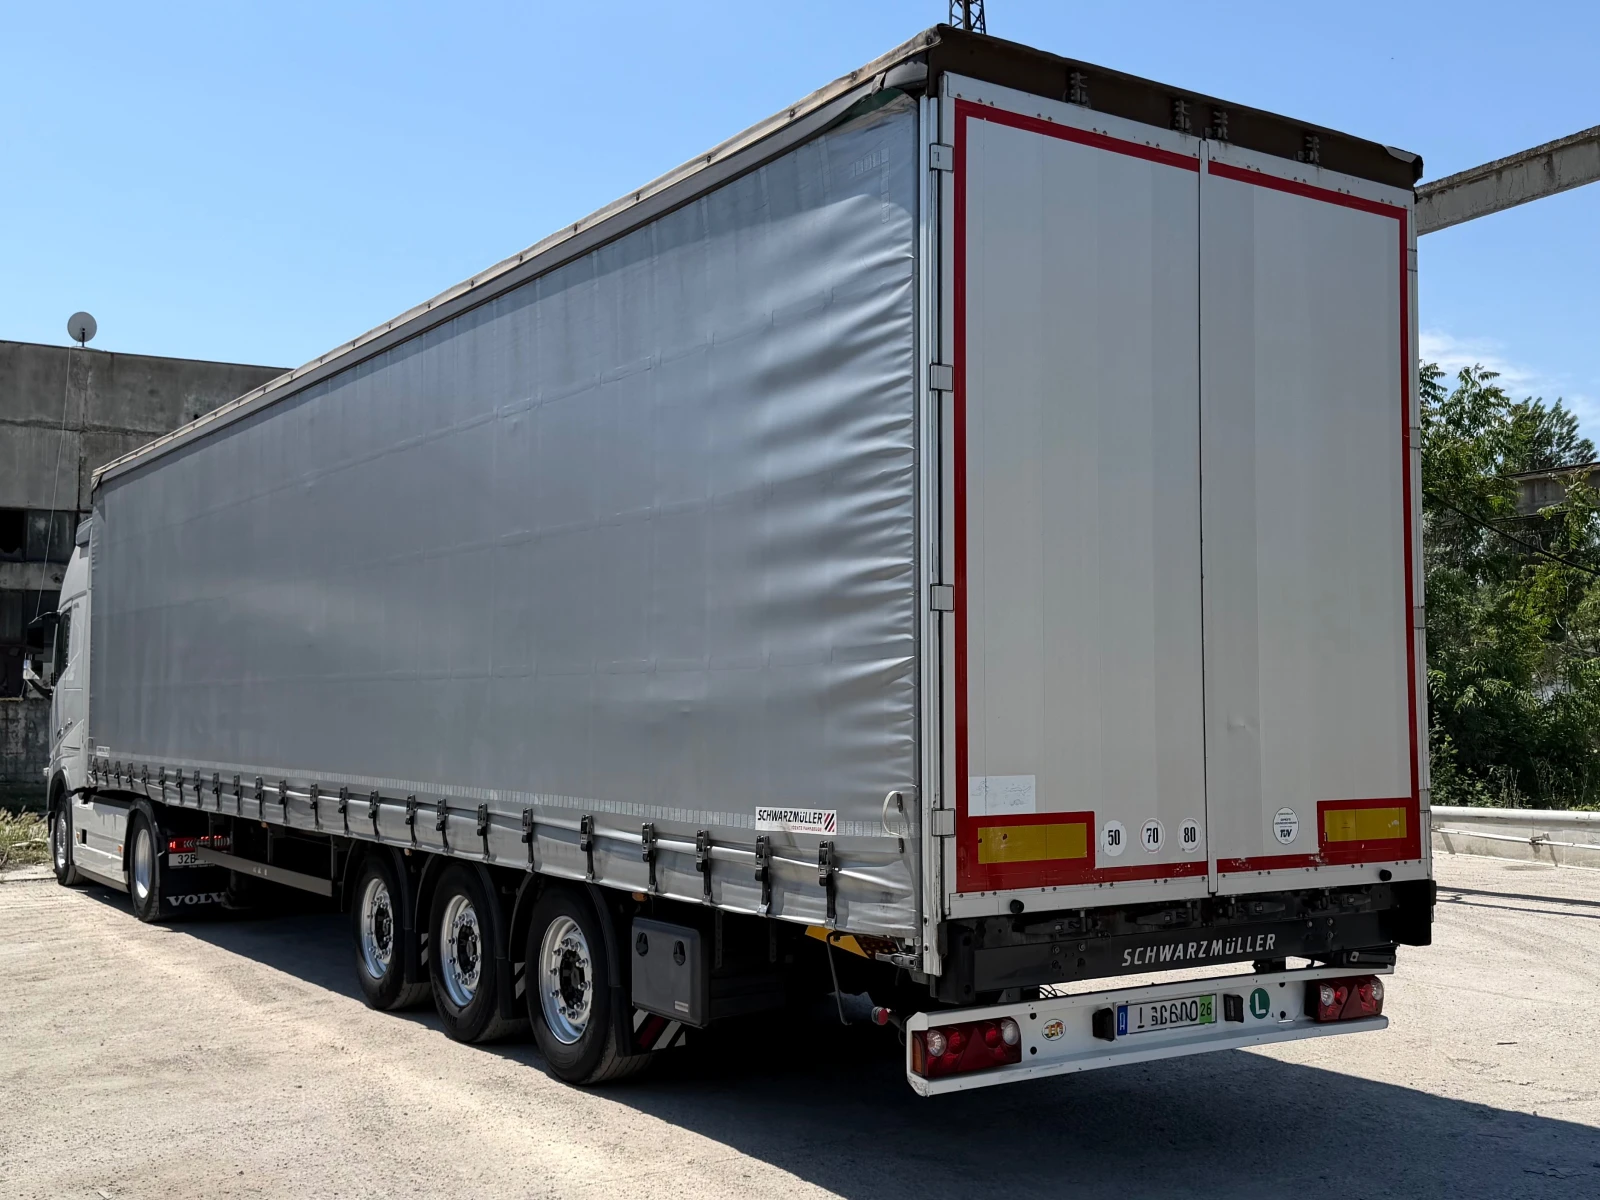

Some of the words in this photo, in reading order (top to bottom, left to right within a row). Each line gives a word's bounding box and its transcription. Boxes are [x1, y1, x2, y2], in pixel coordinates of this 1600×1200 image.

[757, 809, 823, 825] SCHWARZMÜLLER
[1107, 829, 1121, 846] 50
[1146, 827, 1159, 844] 70
[1183, 826, 1196, 843] 80
[166, 892, 226, 907] VOLV
[1121, 933, 1276, 967] SCHWARZMÜLLER
[1200, 1002, 1212, 1017] 26
[1255, 993, 1267, 1014] L
